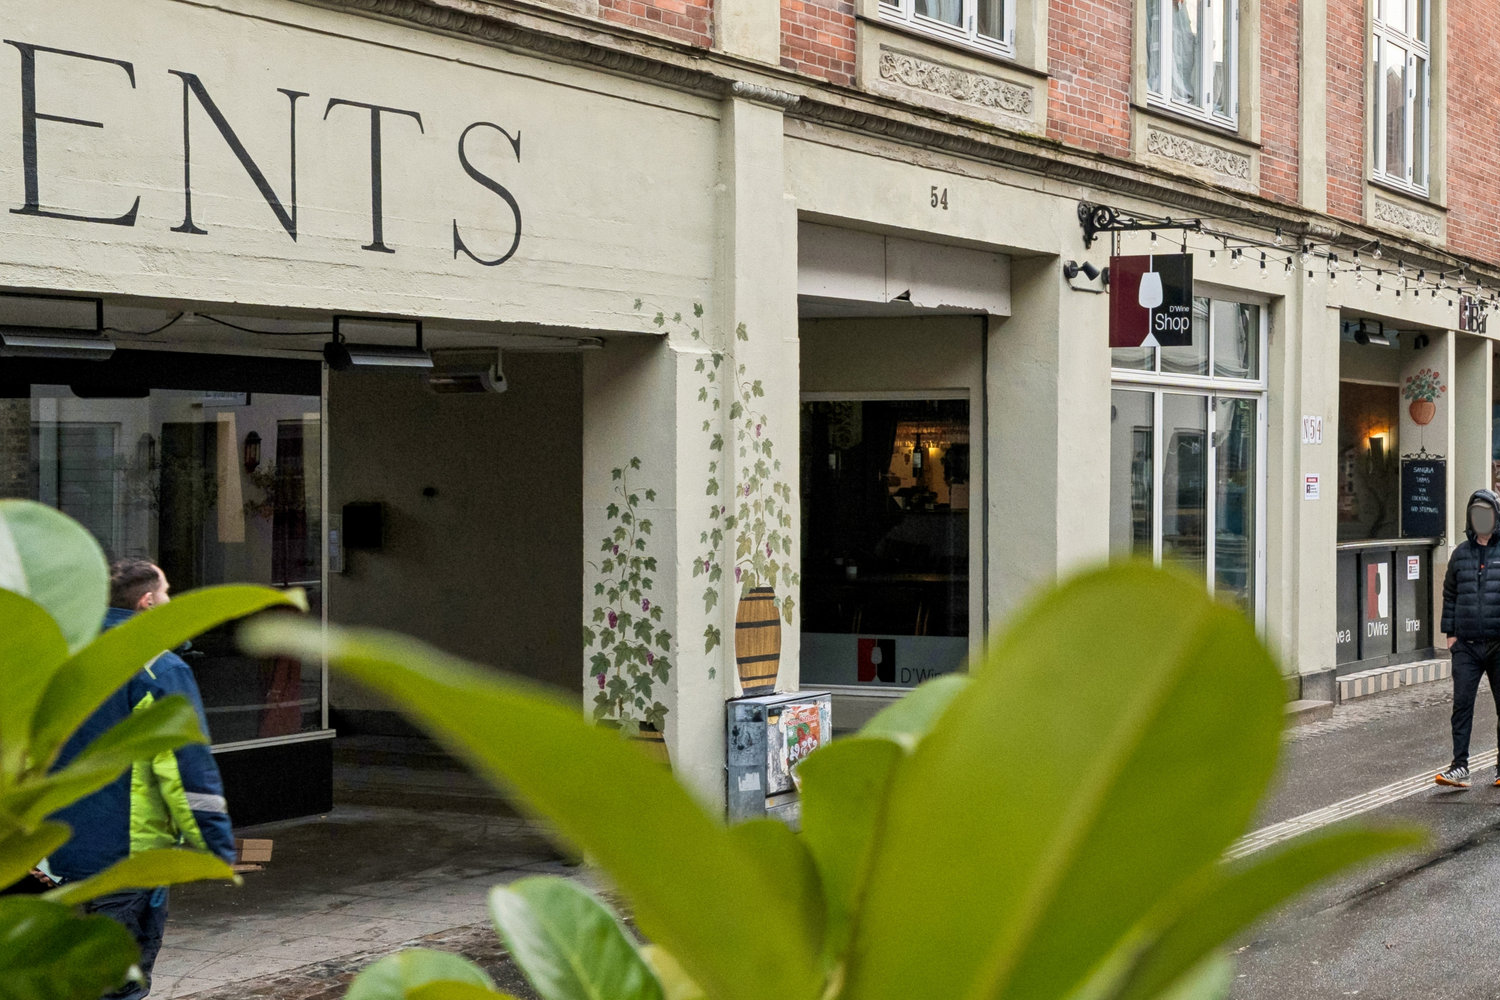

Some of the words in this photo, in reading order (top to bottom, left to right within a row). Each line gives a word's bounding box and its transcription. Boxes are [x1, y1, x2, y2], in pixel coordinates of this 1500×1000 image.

[3, 39, 522, 267] ENTS
[930, 185, 949, 211] 54
[1169, 305, 1190, 313] D'Wine
[1154, 312, 1190, 335] Shop
[1345, 629, 1351, 643] a
